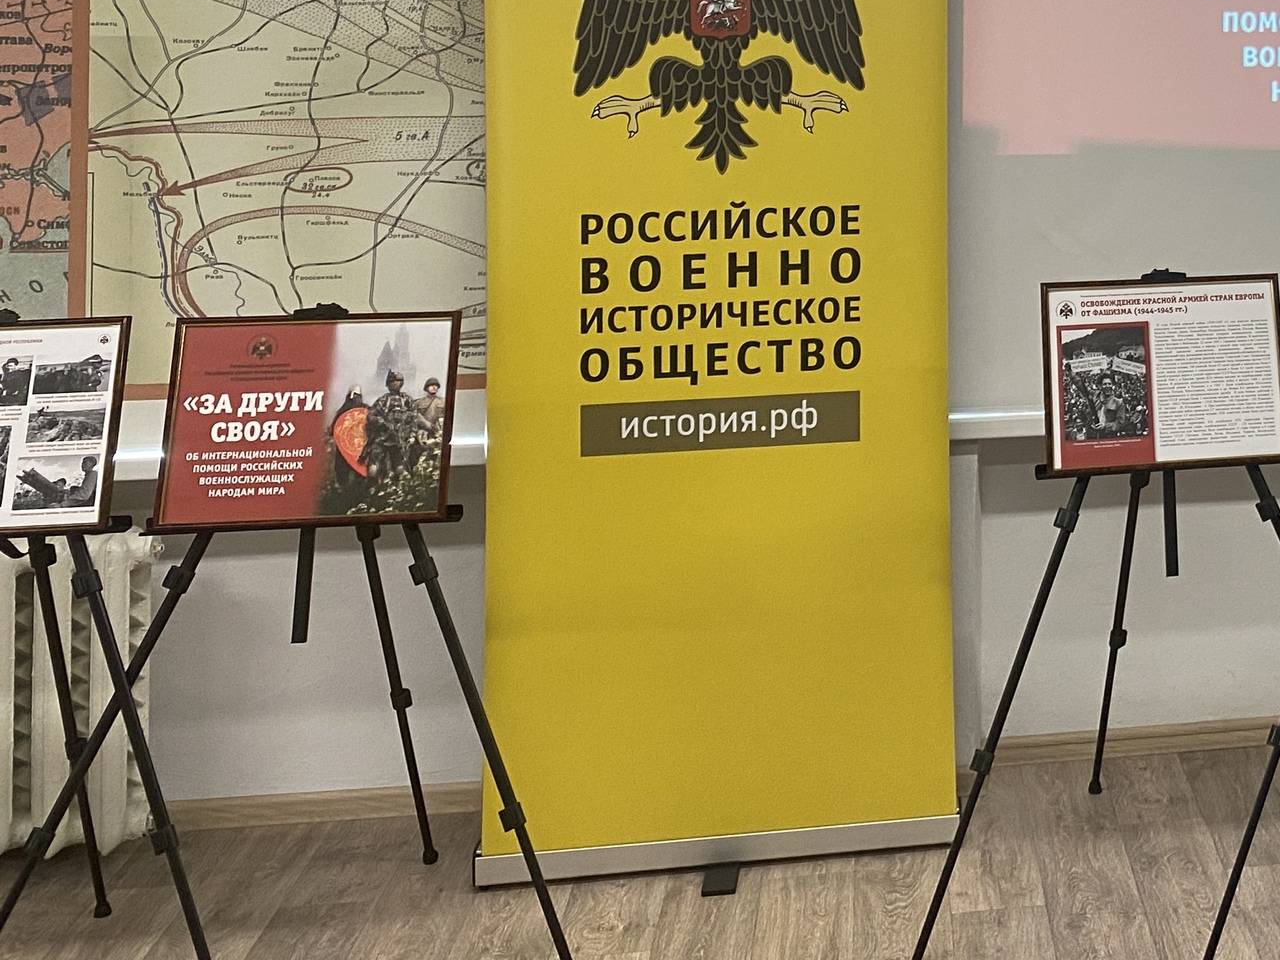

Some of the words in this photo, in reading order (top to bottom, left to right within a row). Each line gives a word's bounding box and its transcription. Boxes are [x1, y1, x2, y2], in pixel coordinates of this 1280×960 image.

[580, 201, 861, 245] РОССИЙСКОЕ
[580, 247, 861, 294] ВОЕННО
[1080, 298, 1141, 309] ОСВОБОЖДЕНИЕ
[1142, 296, 1177, 306] КРАСНОЙ
[1178, 294, 1208, 304] АРМИЕЙ
[1209, 294, 1234, 302] СТРАН
[1235, 292, 1265, 302] ЕВРОПЫ
[580, 296, 861, 334] ИСТОРИЧЕСКОЕ
[1080, 309, 1092, 318] ОТ
[1092, 308, 1132, 317] ФАШИЗМА
[1134, 306, 1174, 316] (1944-1945
[580, 336, 862, 385] ОБЩЕСТВО
[183, 393, 233, 415] «ЗА
[237, 390, 324, 417] ДРУГИ
[211, 420, 296, 442] СВОЯ»
[620, 400, 818, 442] история.рф
[185, 452, 199, 461] ОБ
[201, 446, 313, 461] ИНТЕРНАЦИОНАЛЬНОЙ
[193, 463, 238, 474] ПОМОЩИ
[240, 459, 303, 472] РОССИЙСКИХ
[199, 473, 295, 486] ВОЕННОСЛУЖАЩИХ
[208, 487, 255, 499] НАРОДАМ
[257, 486, 286, 496] МИРА
